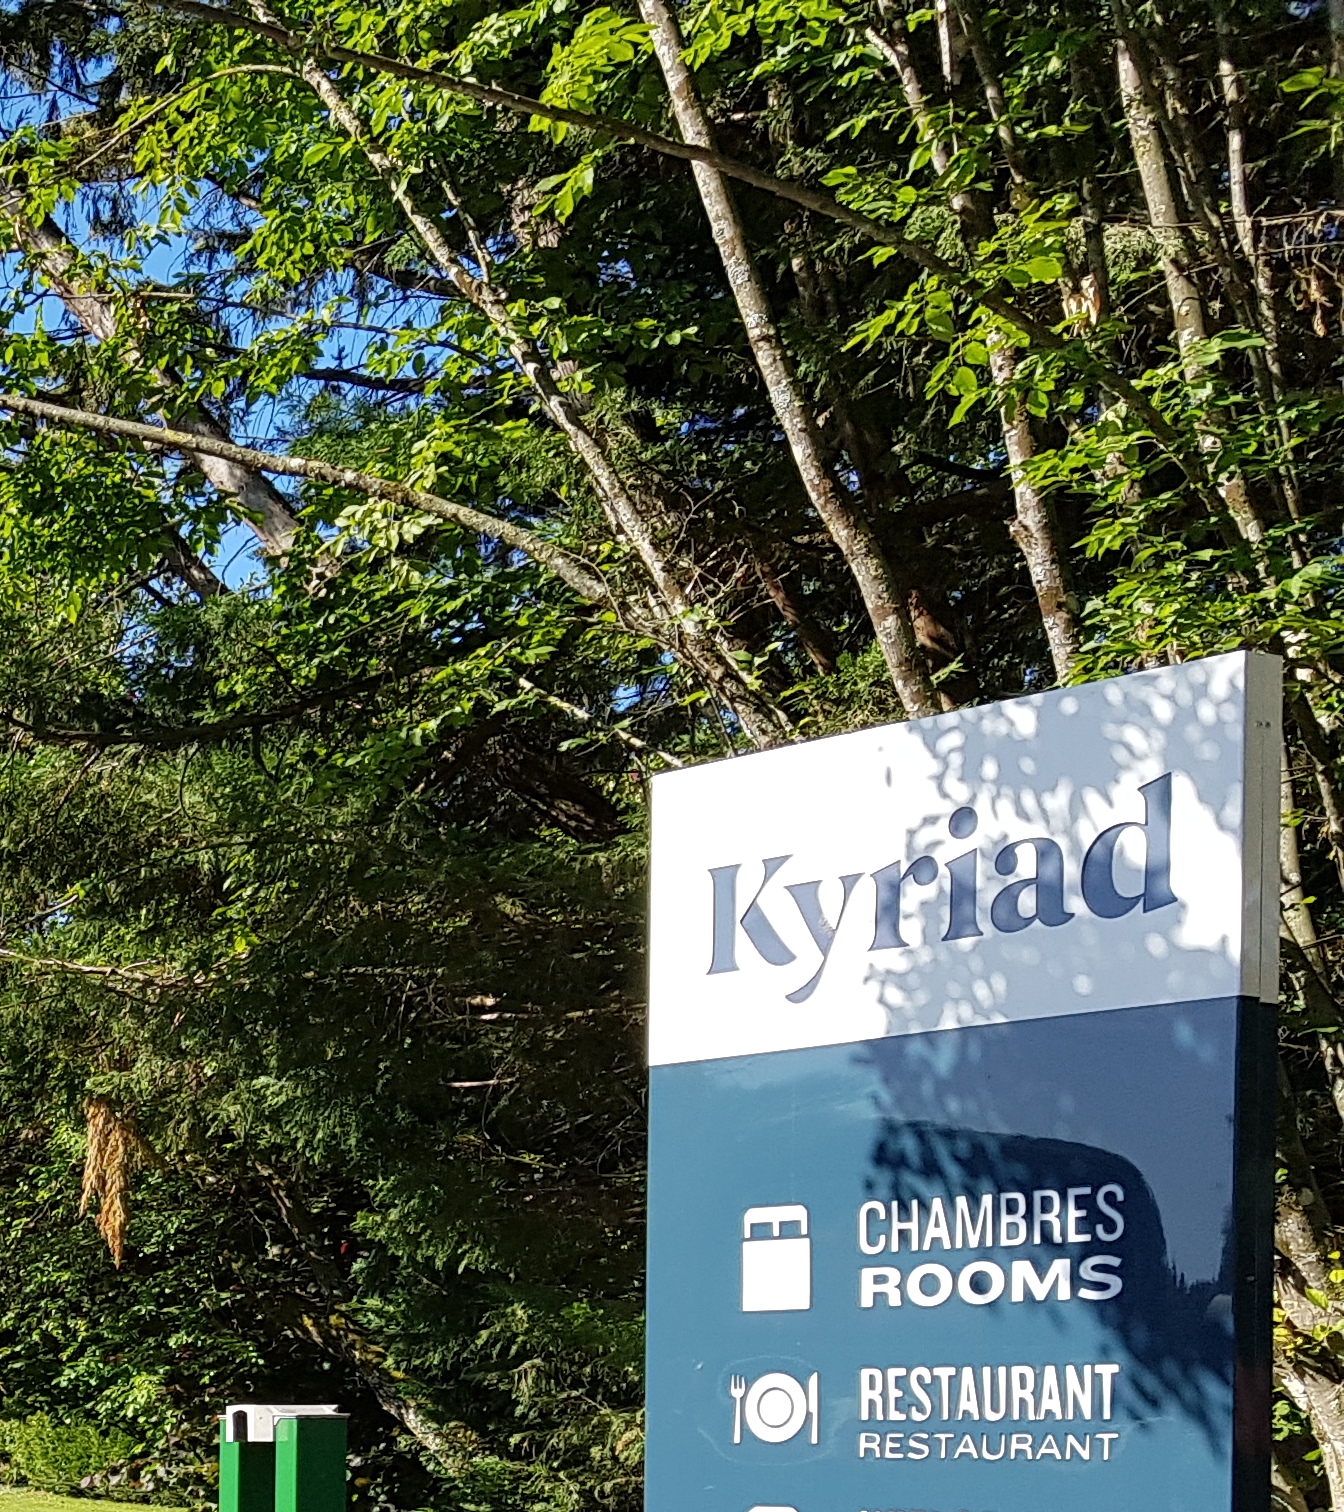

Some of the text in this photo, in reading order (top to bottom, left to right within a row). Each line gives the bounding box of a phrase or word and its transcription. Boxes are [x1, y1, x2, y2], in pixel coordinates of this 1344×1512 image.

[706, 771, 1179, 1004] Kyriad
[858, 1183, 1125, 1255] CHAMBRES
[859, 1255, 1124, 1308] ROOMS
[859, 1364, 1120, 1422] RESTAURANT
[858, 1432, 1119, 1461] RESTAURANT
